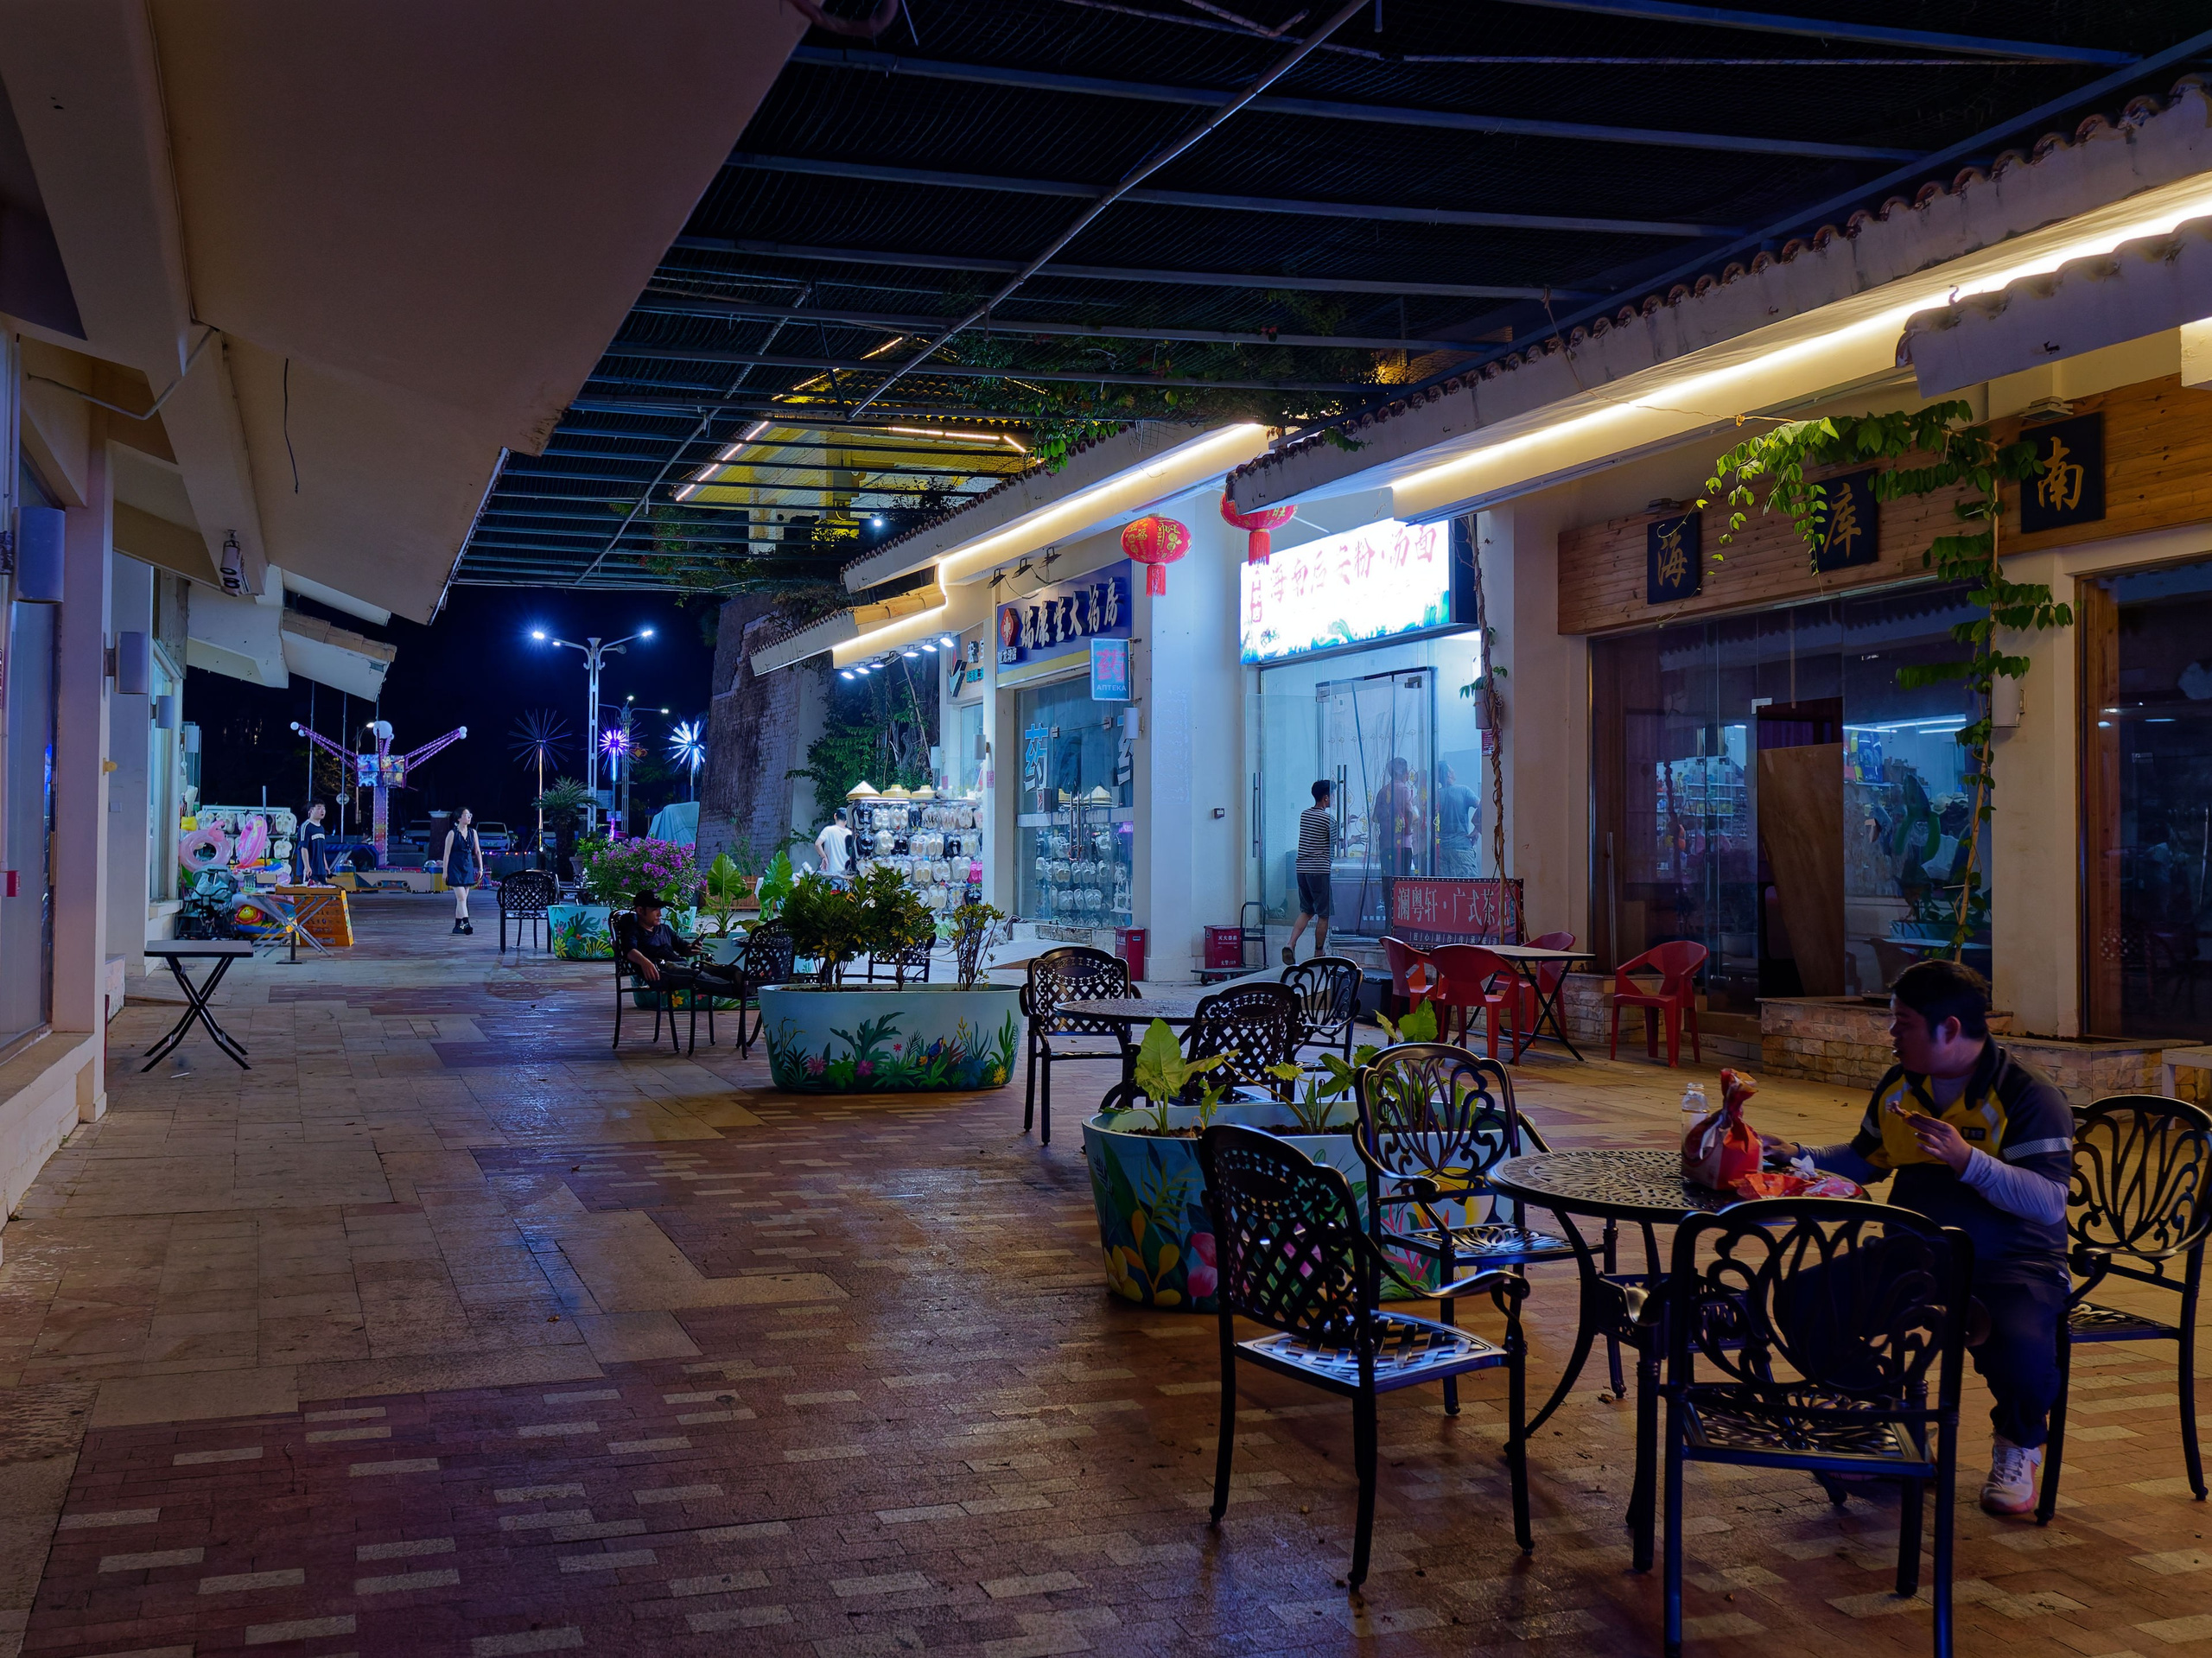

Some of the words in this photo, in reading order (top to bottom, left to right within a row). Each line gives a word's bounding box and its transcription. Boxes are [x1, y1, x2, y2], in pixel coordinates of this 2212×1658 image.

[1657, 529, 1688, 588] 海
[2037, 435, 2084, 511] 南
[1096, 649, 1127, 682] 药
[1024, 722, 1049, 792] 药
